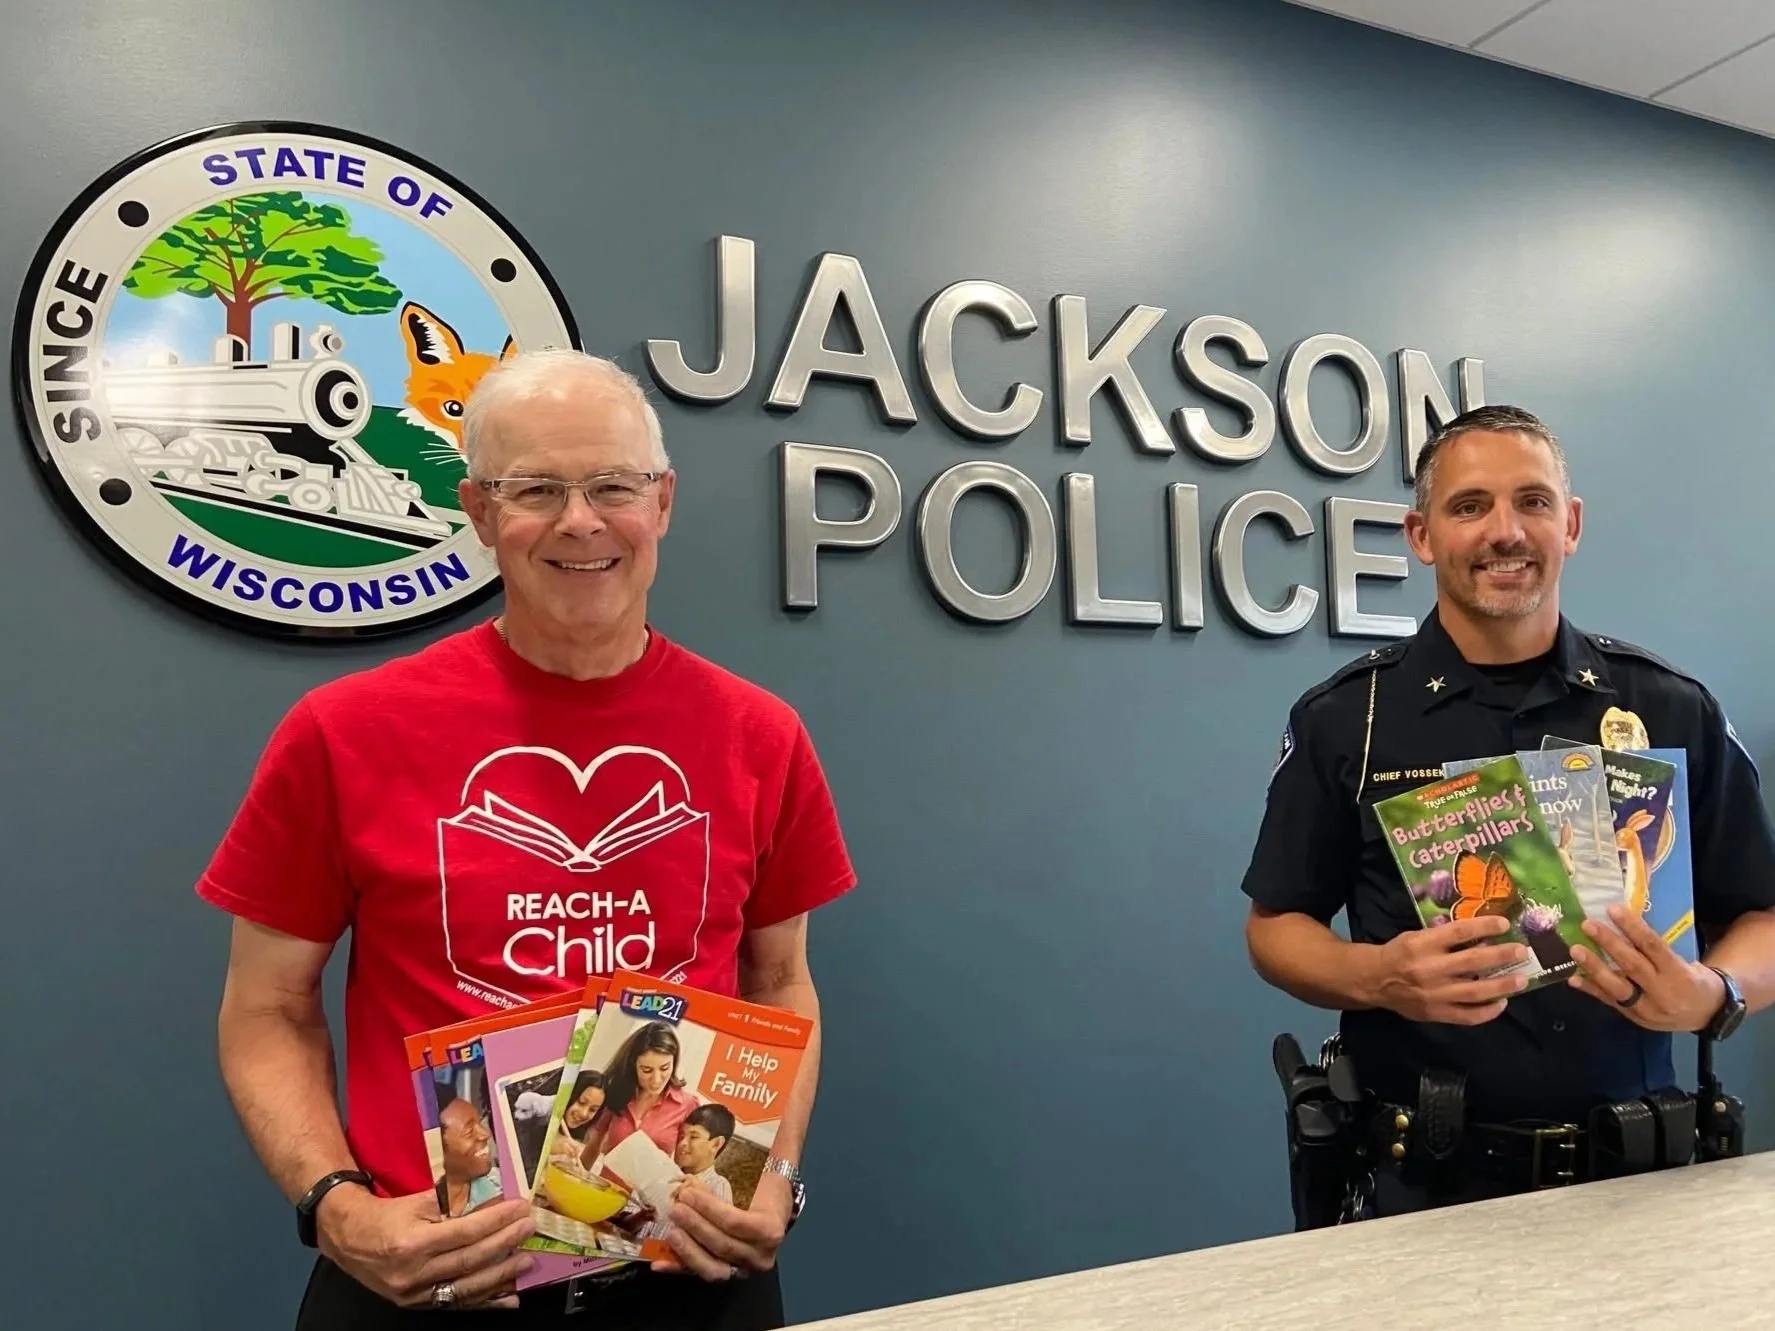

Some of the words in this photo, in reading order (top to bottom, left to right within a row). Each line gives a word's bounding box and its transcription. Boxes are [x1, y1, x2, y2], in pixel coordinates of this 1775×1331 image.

[203, 147, 366, 189] STATE
[387, 176, 454, 221] OF
[46, 259, 109, 444] SINCE
[646, 234, 1486, 484] JACKSON
[780, 440, 1419, 638] POLICE
[167, 533, 470, 614] WISCONSIN
[1373, 771, 1401, 782] CHIEF
[1605, 763, 1642, 782] Makes
[1423, 796, 1446, 809] TRUE
[1454, 785, 1478, 799] FALSE
[1534, 797, 1582, 814] now
[1611, 779, 1658, 800] Night?
[1392, 789, 1514, 845] Butterflies
[507, 889, 651, 921] REACH-A
[503, 920, 656, 978] Child
[622, 992, 682, 1021] LEAD21
[726, 1043, 734, 1061] I
[737, 1046, 779, 1074] Help
[710, 1071, 779, 1109] Family
[742, 1066, 760, 1084] My
